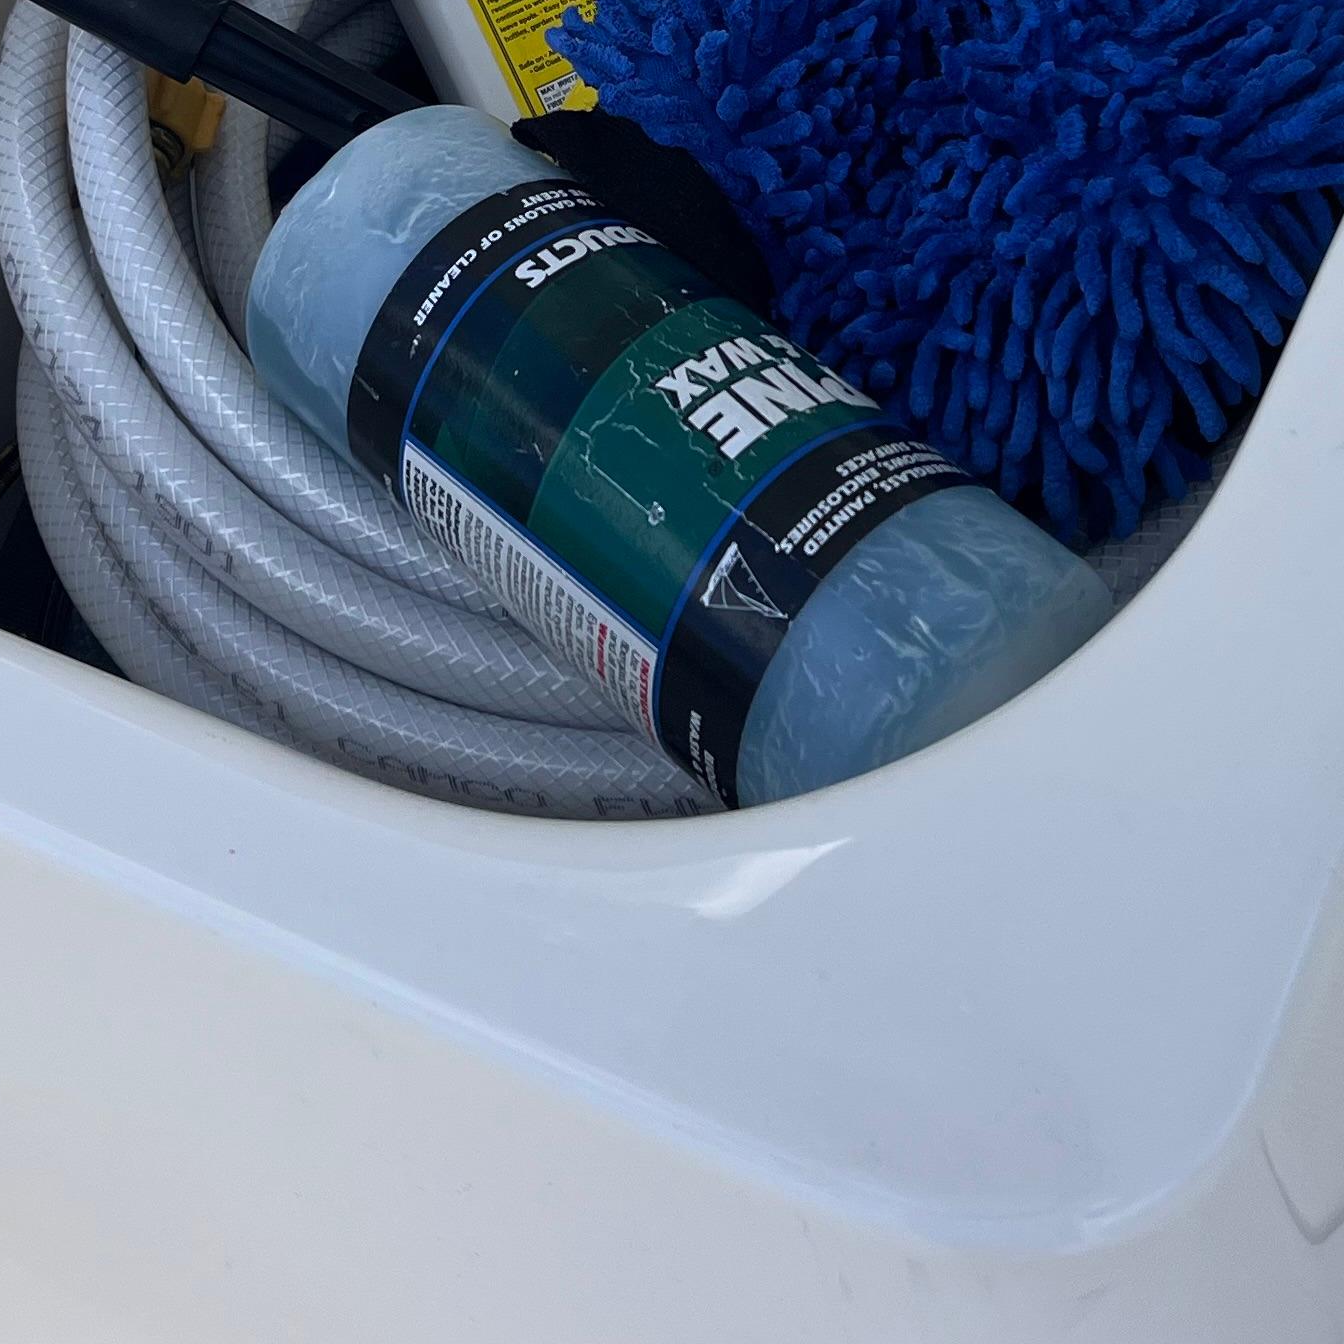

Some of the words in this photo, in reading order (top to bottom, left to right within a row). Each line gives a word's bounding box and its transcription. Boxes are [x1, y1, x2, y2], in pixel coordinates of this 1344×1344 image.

[543, 3, 560, 13] Easy
[540, 84, 555, 95] MAY
[504, 199, 575, 232] GALLONS
[521, 189, 567, 208] SCENT
[480, 229, 503, 251] OF
[515, 225, 659, 288] ODUCTS
[413, 249, 478, 326] CLEANER
[656, 337, 778, 411] WAX
[835, 441, 910, 477] SURFACES
[774, 467, 881, 554] ENCLOSURES,
[803, 491, 876, 556] PAINTED
[690, 710, 702, 756] WASH
